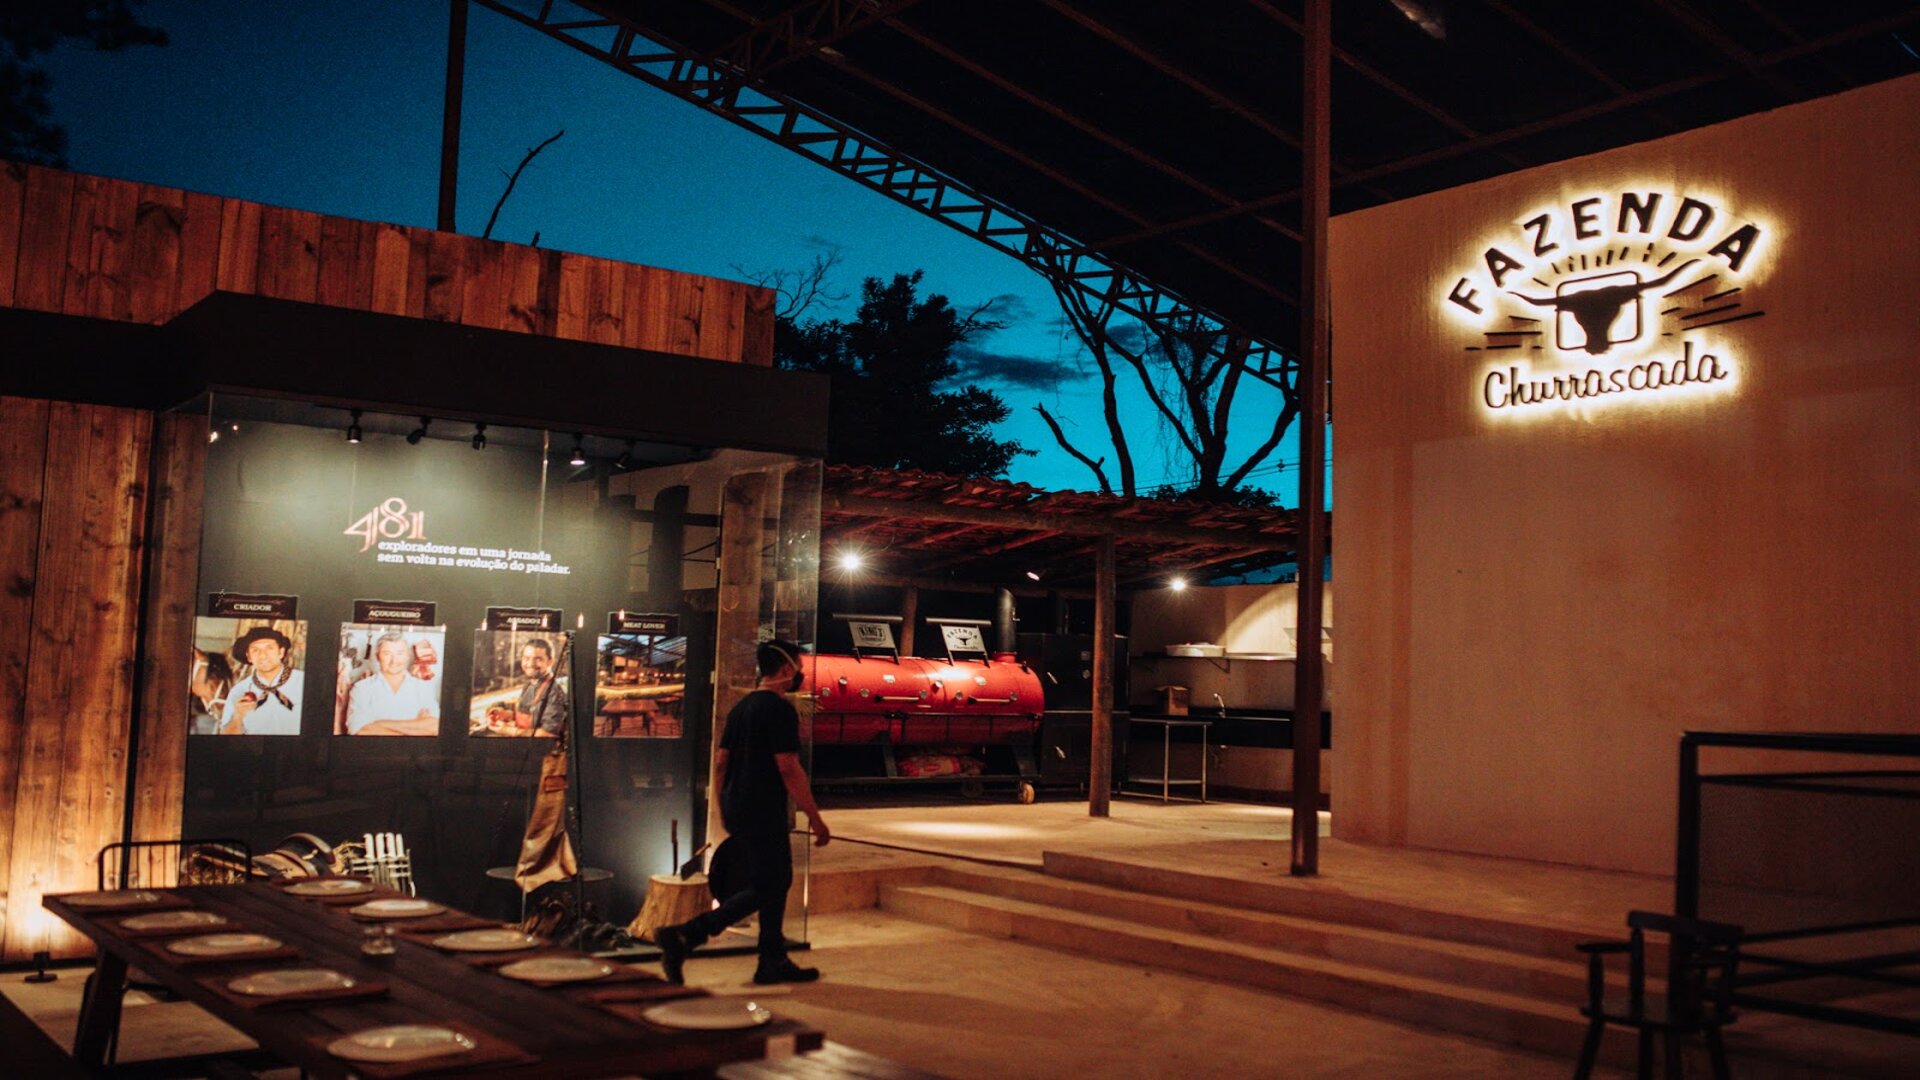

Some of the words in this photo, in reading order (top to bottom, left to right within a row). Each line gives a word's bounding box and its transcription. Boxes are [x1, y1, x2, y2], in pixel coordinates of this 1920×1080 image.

[1448, 192, 1761, 315] FAZENDA
[1485, 341, 1728, 408] Churrascada
[343, 497, 427, 553] 481
[378, 540, 457, 555] exploradores
[458, 547, 478, 556] em
[480, 548, 506, 558] uma
[507, 548, 552, 561] jornada
[377, 553, 404, 563] sem
[406, 554, 437, 565] volta
[438, 557, 454, 566] na
[456, 557, 508, 571] evolução
[509, 561, 525, 571] do
[525, 562, 571, 574] paladar.
[233, 602, 272, 612] CRIADOR
[368, 610, 421, 618] AÇOUGUEIRO
